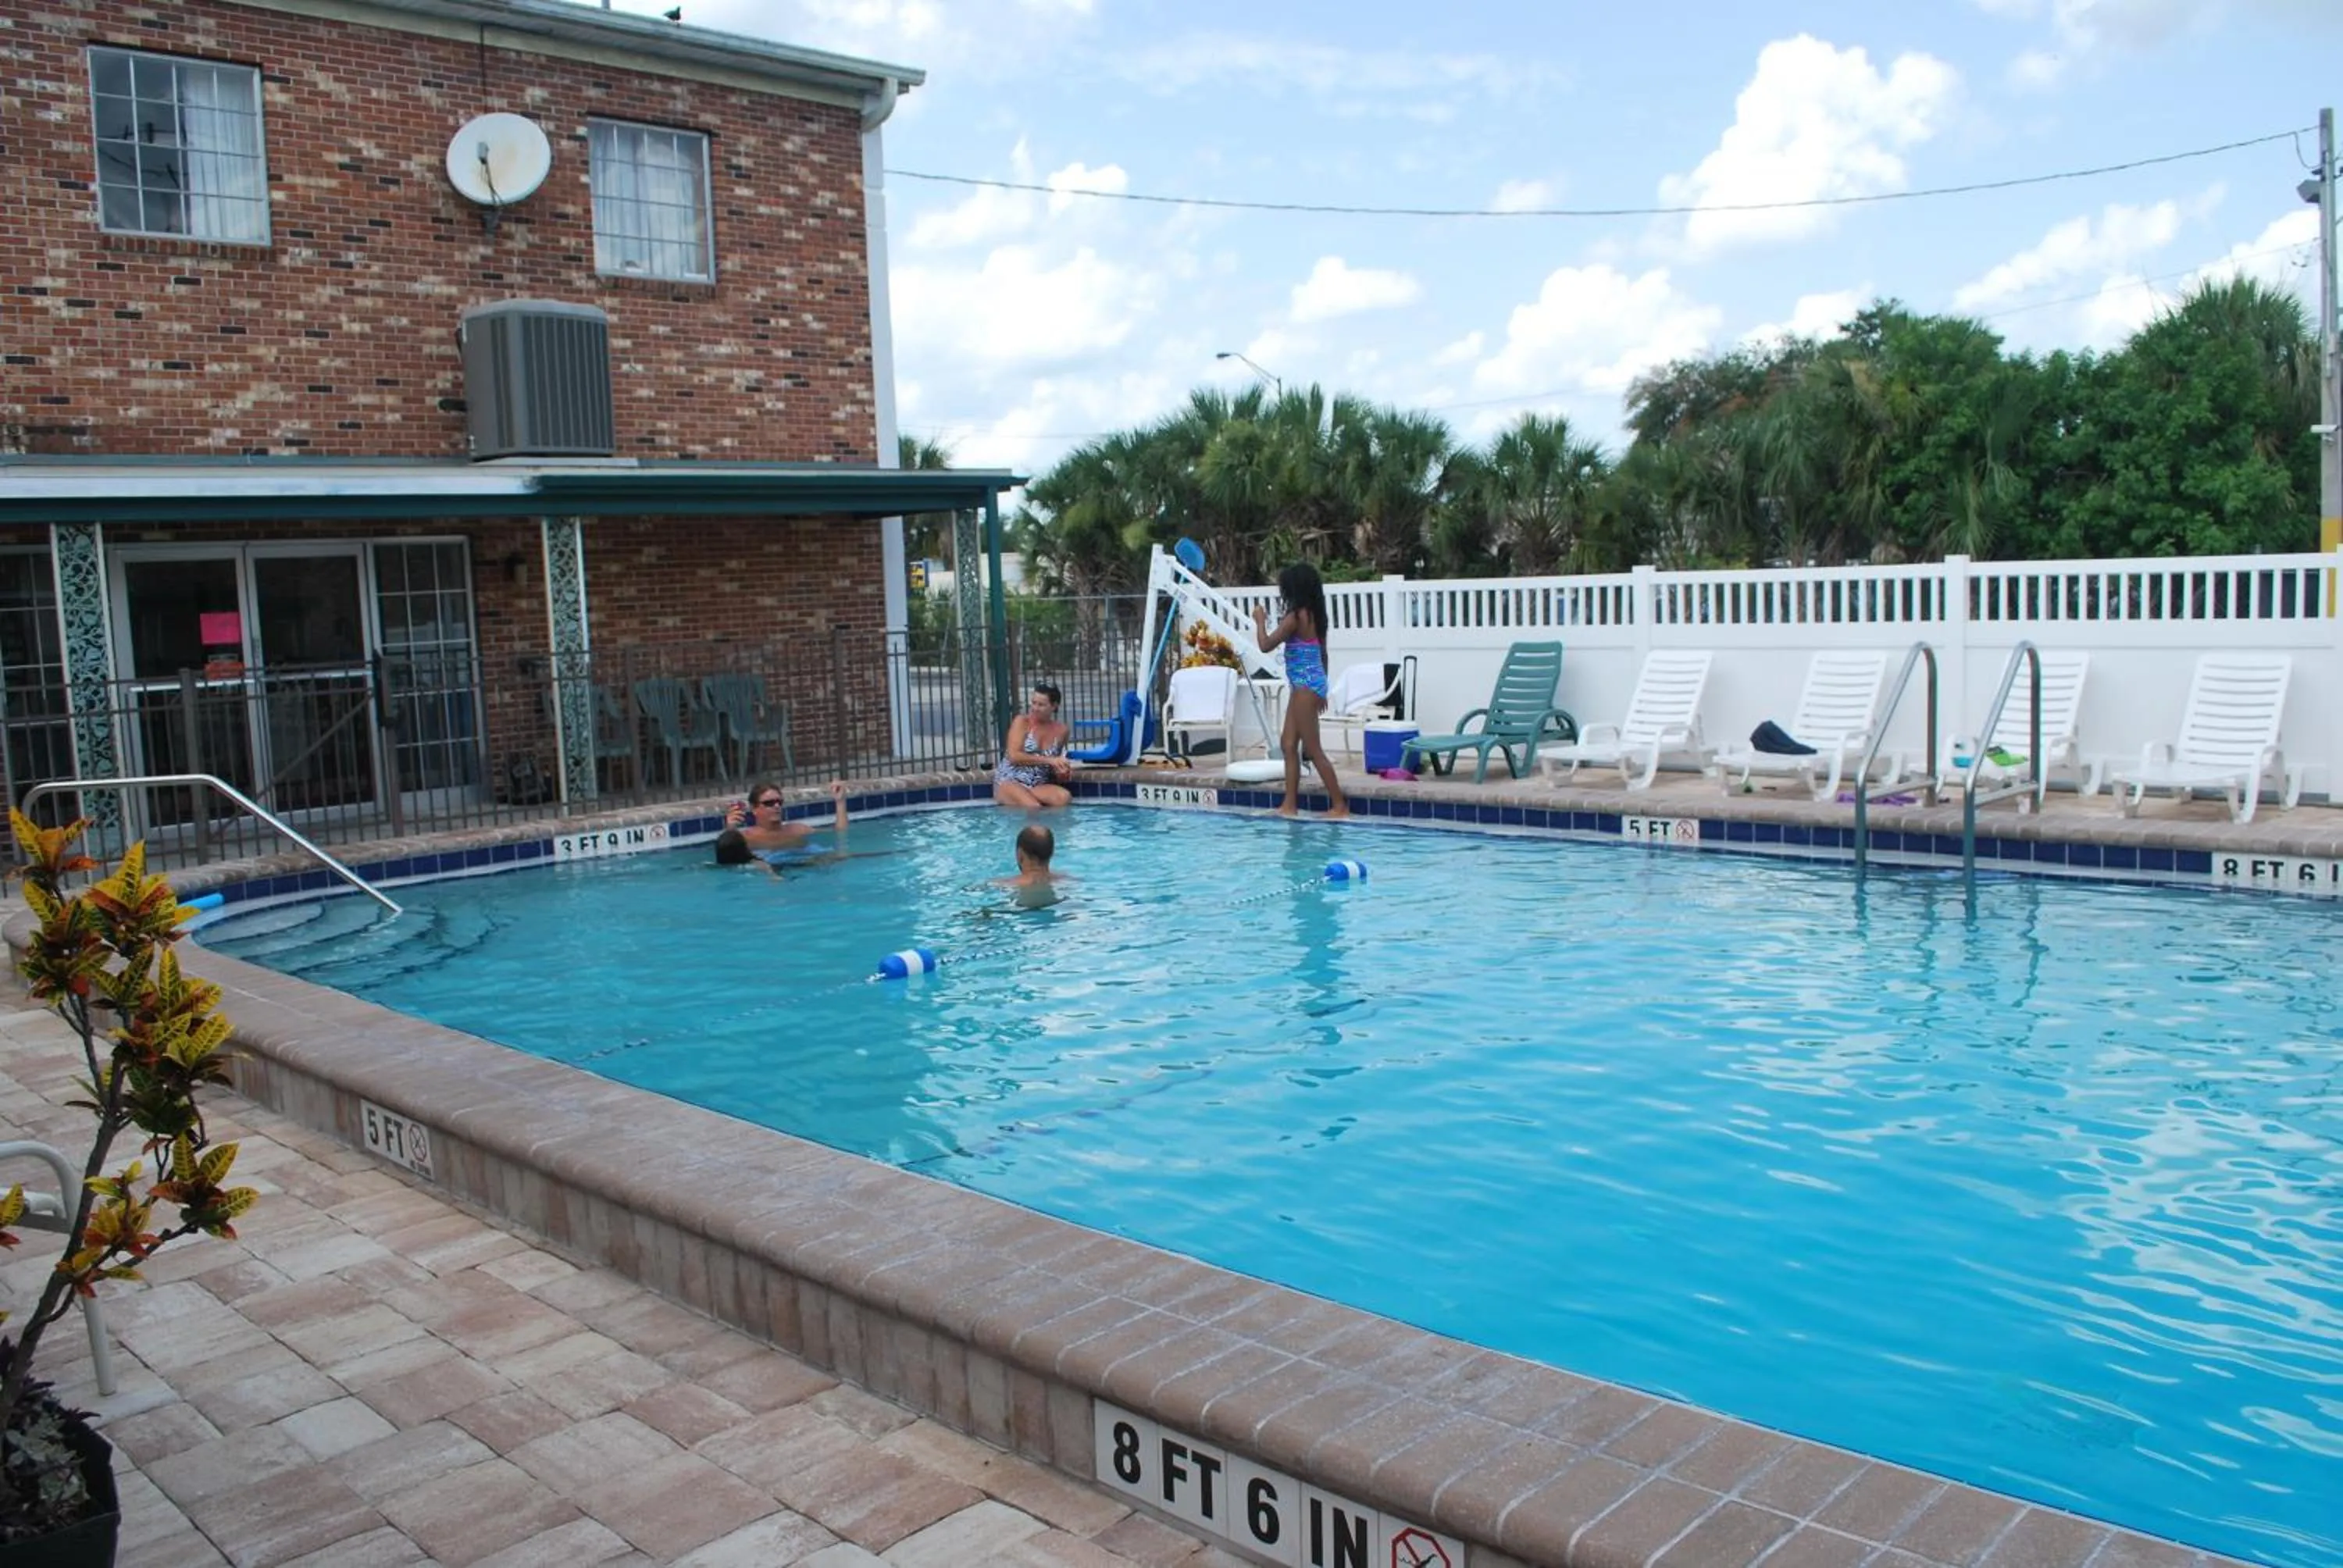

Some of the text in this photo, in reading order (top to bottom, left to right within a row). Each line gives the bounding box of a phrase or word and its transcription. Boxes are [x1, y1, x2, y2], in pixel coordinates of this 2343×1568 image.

[1154, 788, 1168, 800] FT
[1186, 789, 1200, 804] IN
[580, 835, 601, 850] FT
[627, 829, 644, 844] IN
[1649, 821, 1671, 836] FT
[2224, 858, 2339, 882] 8 FT 6 I
[367, 1107, 405, 1159] 5 FT
[1113, 1420, 1369, 1568] 8 FT 6 IN
